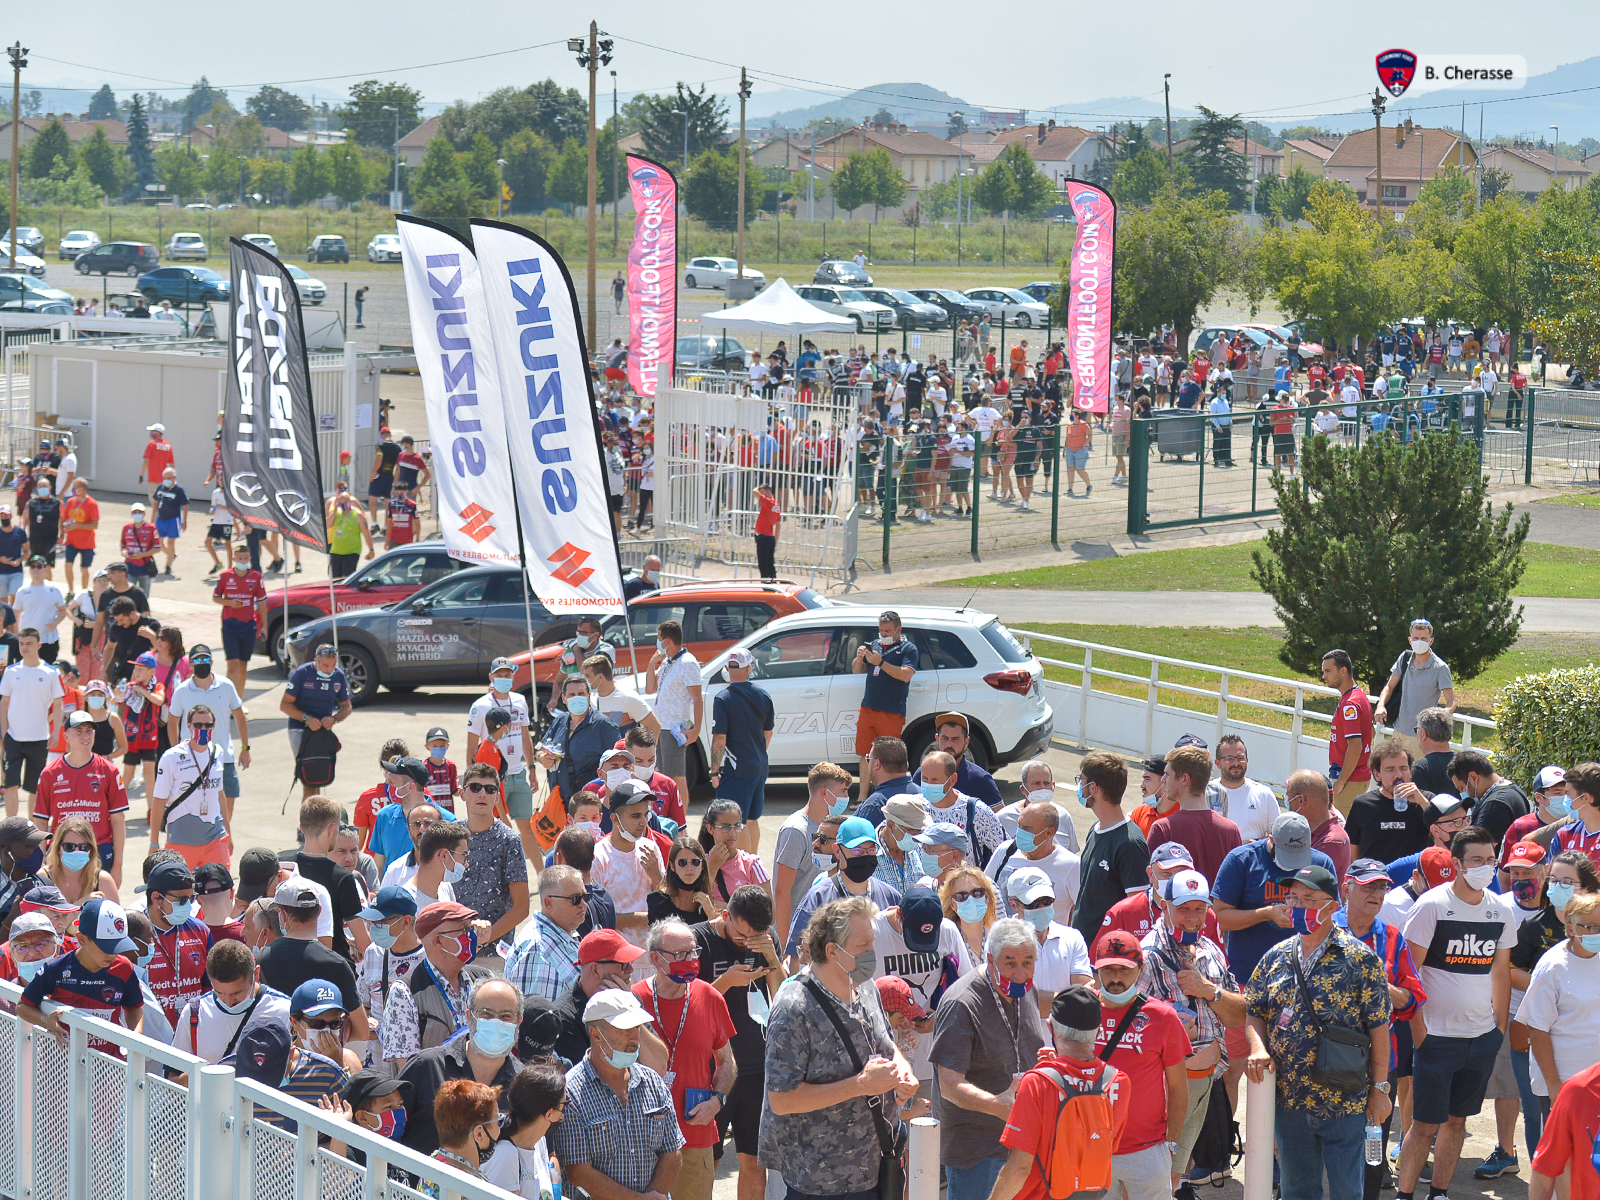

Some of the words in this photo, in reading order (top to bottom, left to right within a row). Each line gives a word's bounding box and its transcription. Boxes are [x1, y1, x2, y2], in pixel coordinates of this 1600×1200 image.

[223, 526, 231, 534] 10
[396, 634, 430, 643] MAZDA
[431, 634, 459, 643] CX-30
[396, 644, 445, 653] SKYACTIV-X
[396, 653, 406, 661] M
[408, 652, 441, 661] HYBRID
[320, 682, 329, 691] 28
[1445, 934, 1496, 957] nike
[884, 951, 941, 976] PUMA
[1445, 955, 1494, 965] sportswear
[149, 962, 168, 970] PATRICK
[148, 980, 171, 990] Crédit
